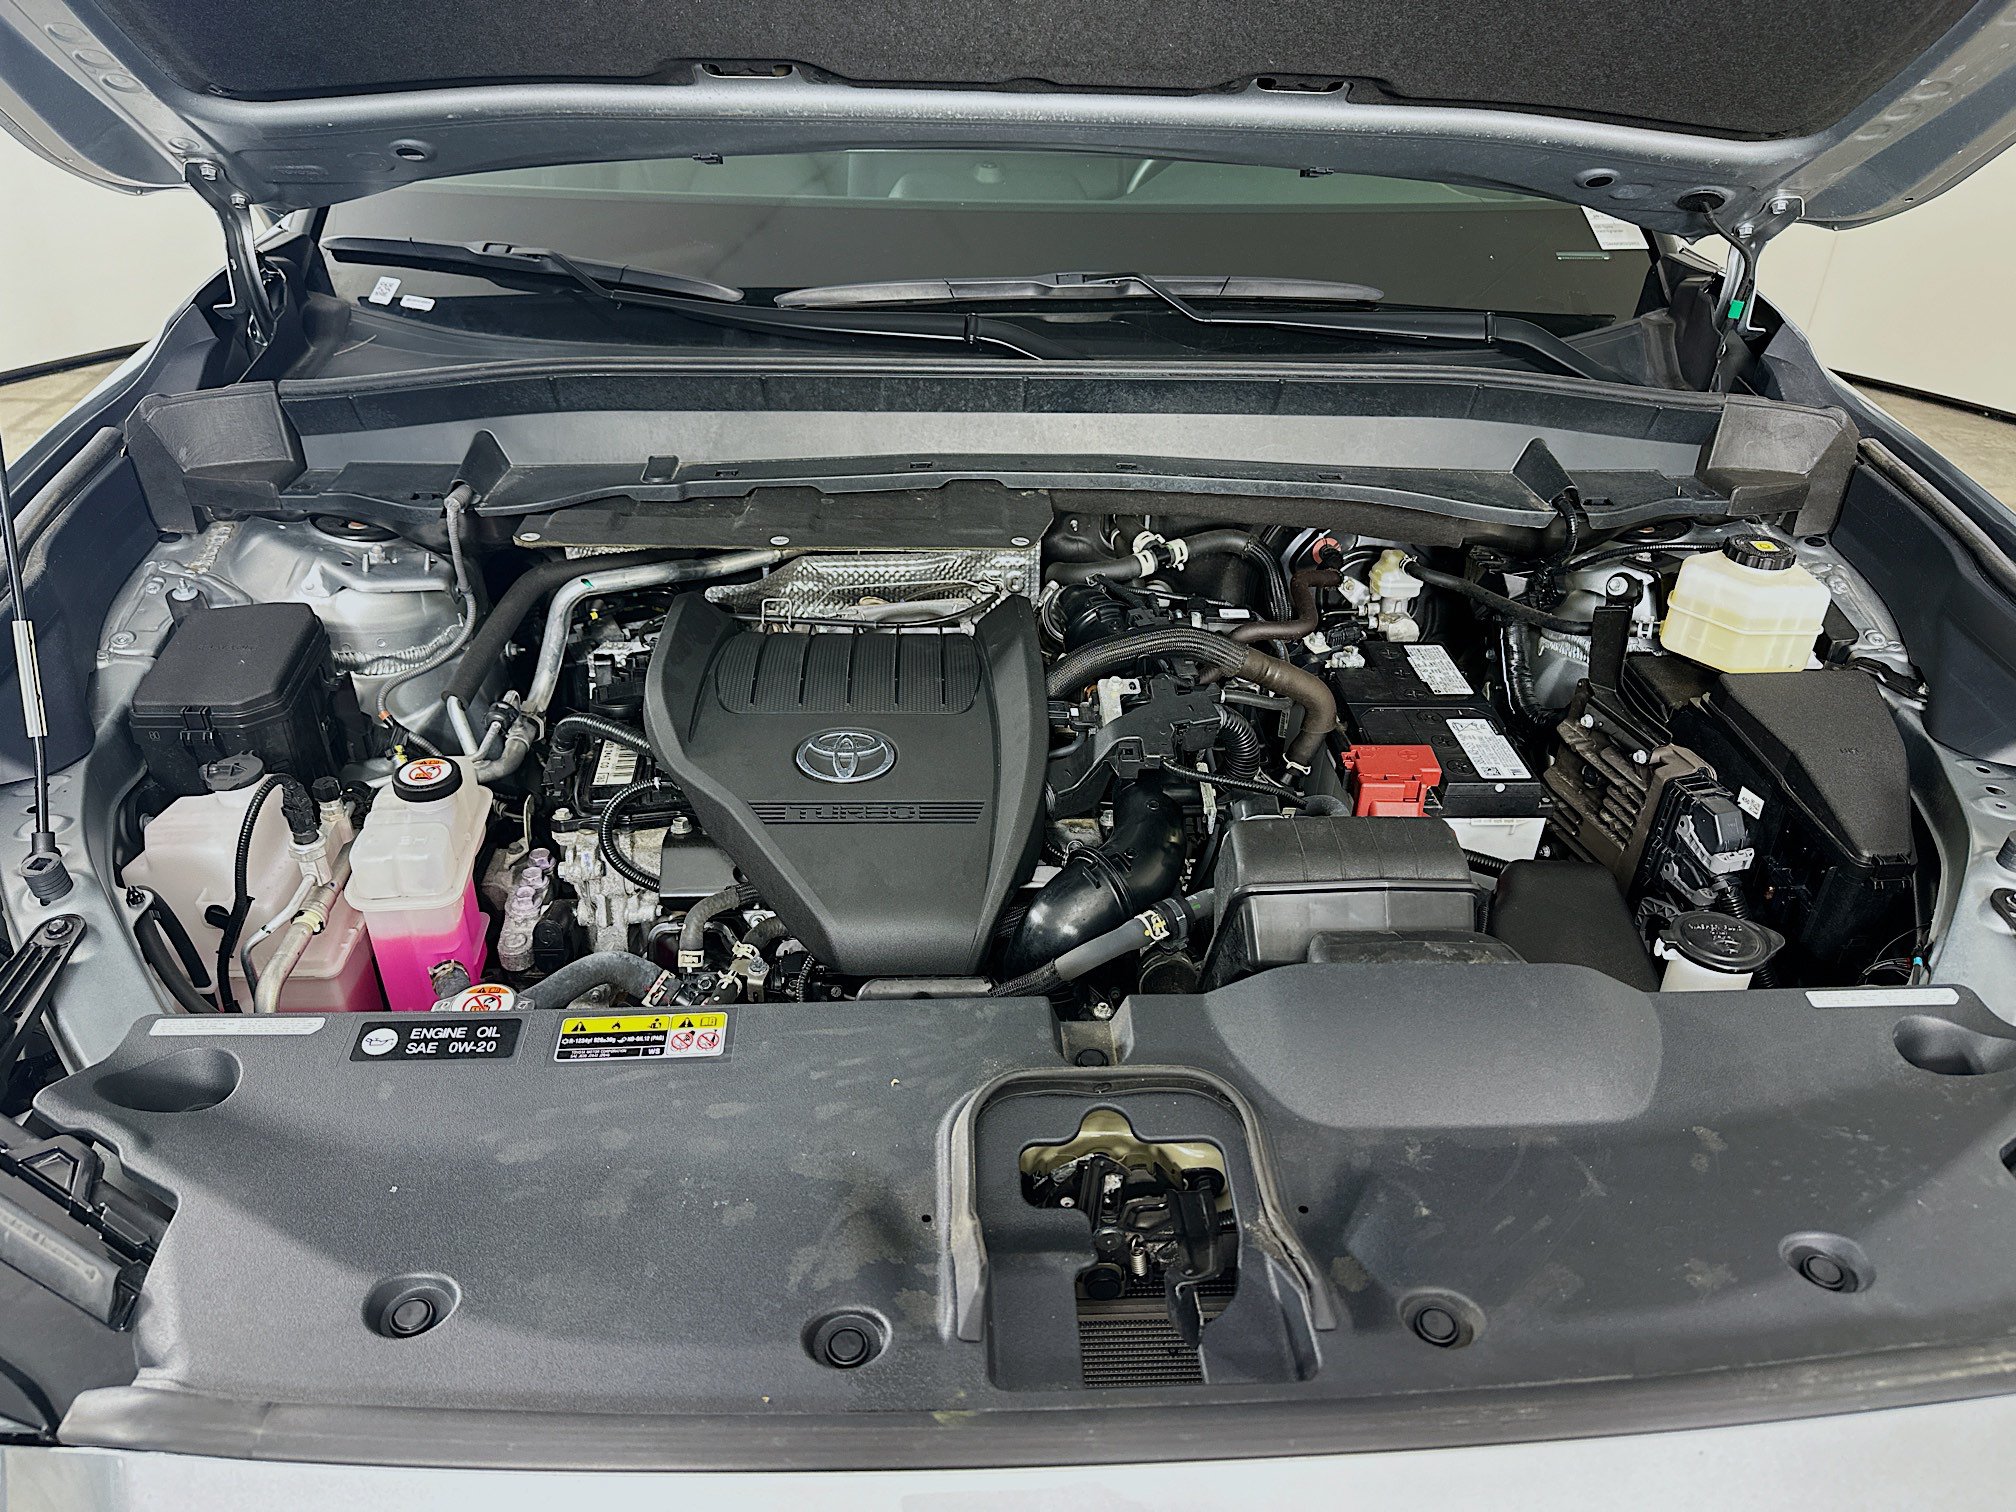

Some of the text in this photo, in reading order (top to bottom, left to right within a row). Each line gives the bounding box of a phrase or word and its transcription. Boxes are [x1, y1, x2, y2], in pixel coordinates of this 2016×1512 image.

[788, 805, 917, 820] TURBO
[410, 1026, 501, 1040] ENGINE OIL
[405, 1040, 497, 1055] SAE 0W-20
